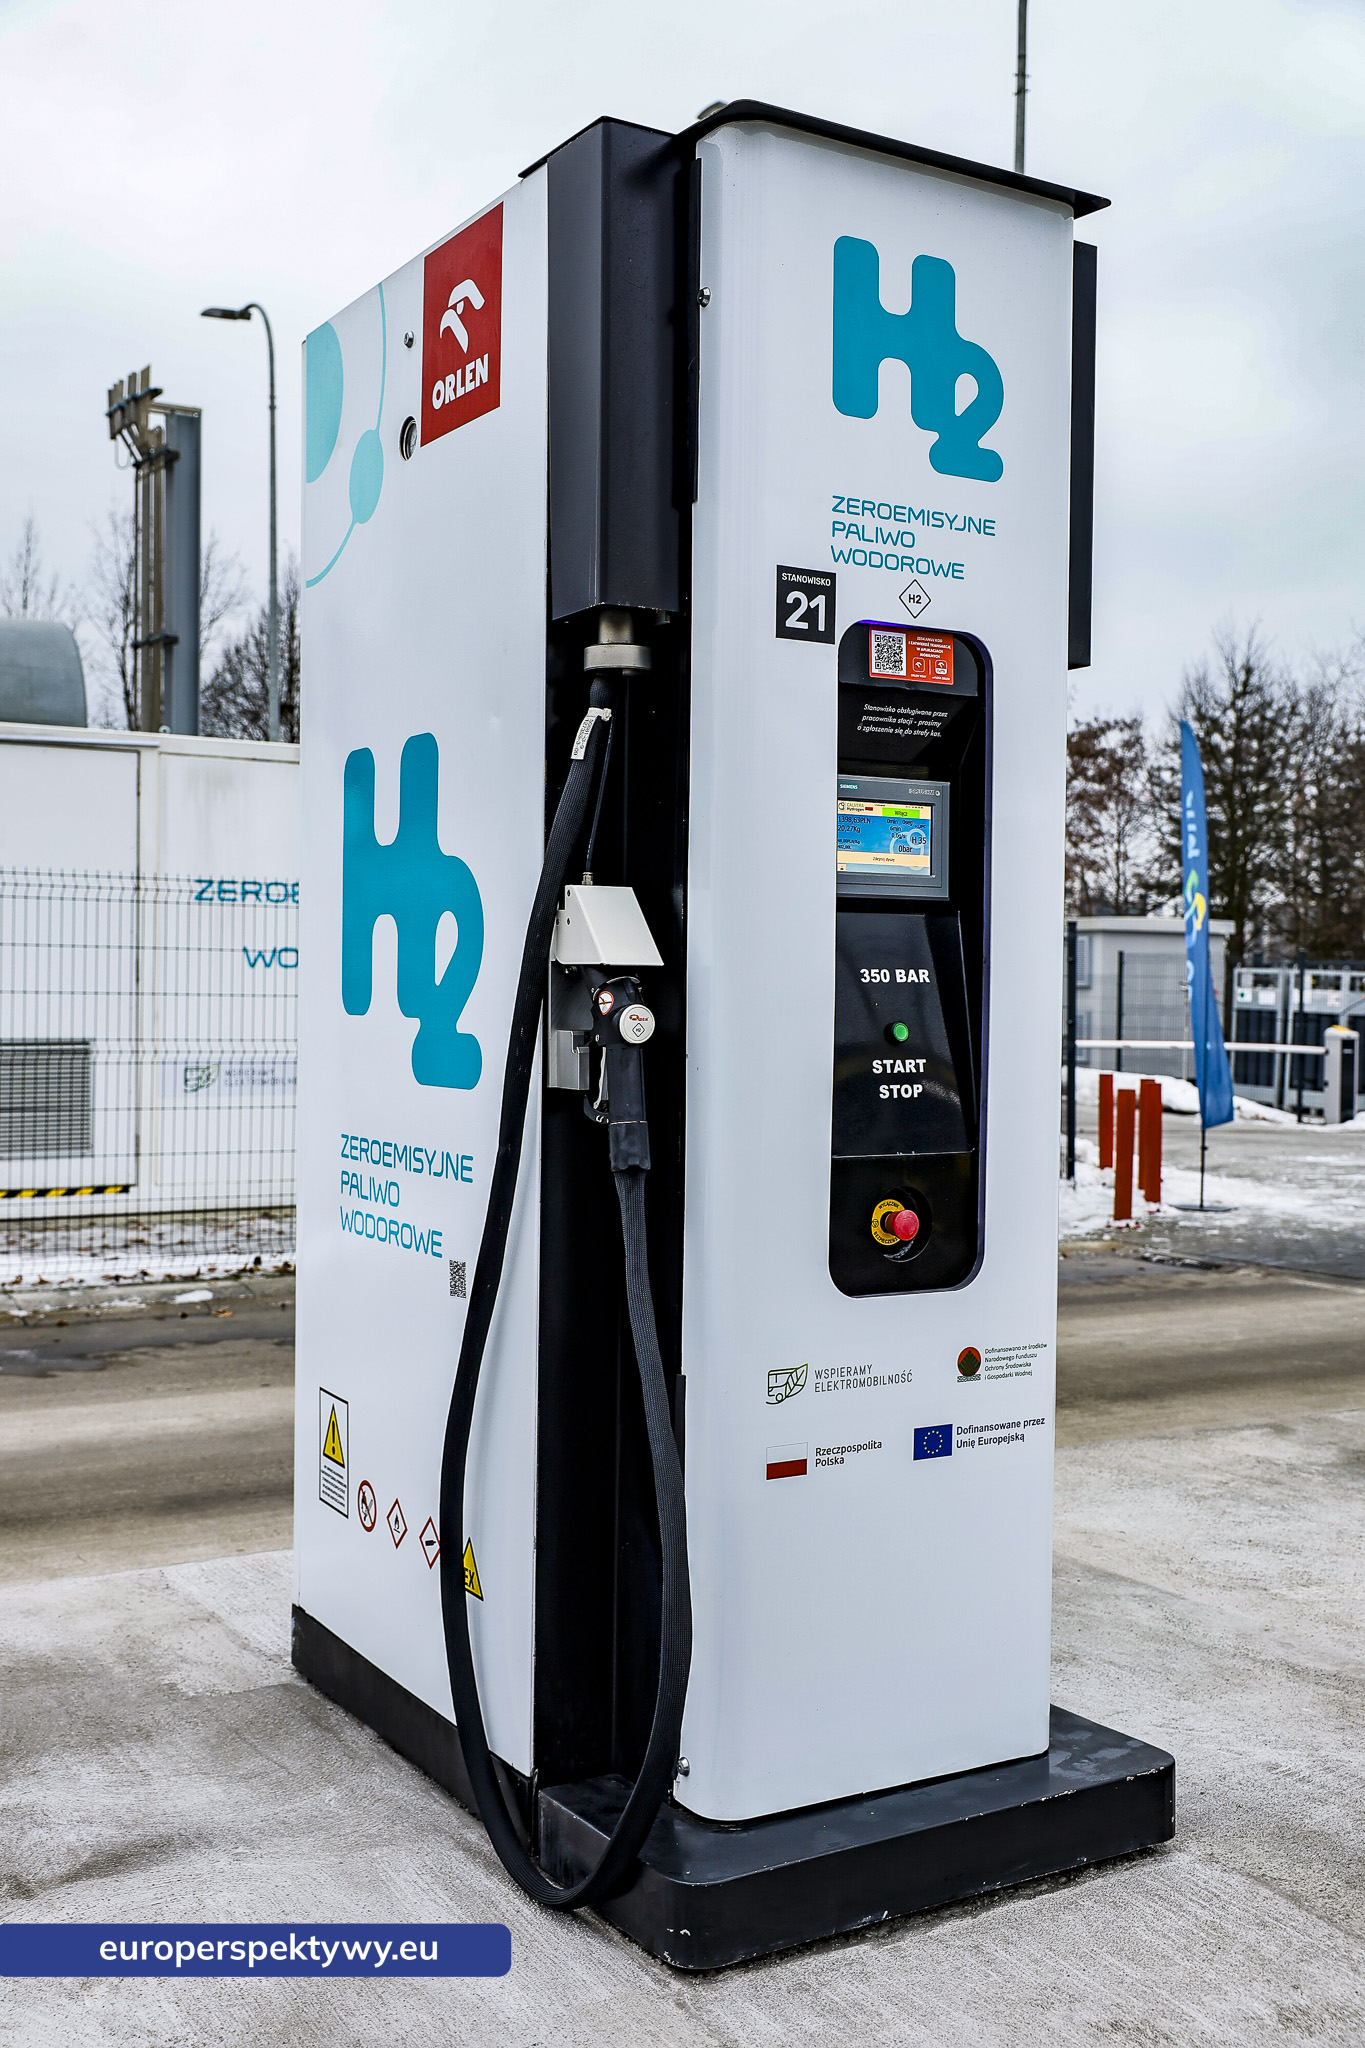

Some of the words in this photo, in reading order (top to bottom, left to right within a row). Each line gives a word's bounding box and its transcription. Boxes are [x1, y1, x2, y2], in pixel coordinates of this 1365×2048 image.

[832, 235, 1004, 483] H2
[432, 352, 489, 410] ORLEN
[831, 495, 996, 537] ZEROEMISYJNE
[831, 520, 916, 549] PALIWO
[830, 545, 966, 580] WODOROWE
[781, 572, 831, 587] STANOWISKO
[908, 594, 922, 605] H2
[785, 590, 826, 632] 21
[864, 703, 896, 713] Stanowisko
[896, 706, 932, 716] obsługiwane
[861, 715, 896, 723] pracownika
[897, 717, 914, 726] stacji
[917, 719, 941, 728] prosimy
[862, 724, 894, 733] zgłoszenie
[894, 726, 904, 735] się
[913, 728, 930, 738] strefy
[341, 732, 485, 1090] H2
[243, 946, 299, 968] WO
[859, 968, 890, 983] 350
[895, 968, 931, 983] BAR
[872, 1058, 926, 1074] START
[879, 1084, 923, 1099] STOP
[340, 1133, 473, 1183] ZEROEMISYJNE
[340, 1170, 400, 1207] PALIWO
[340, 1205, 443, 1258] WODOROWE
[1028, 1342, 1048, 1350] środków
[984, 1355, 1015, 1363] Narodowego
[1005, 1361, 1032, 1370] Środowiska
[814, 1364, 873, 1380] WSPIERAMY
[814, 1369, 913, 1392] ELEKTROMOBILNOŚĆ
[987, 1372, 1014, 1380] Gospodarki
[956, 1421, 1021, 1435] Dofinansowane
[1023, 1417, 1045, 1429] przez
[815, 1440, 882, 1457] Rzeczpospolita
[956, 1438, 976, 1449] Unię
[977, 1432, 1025, 1445] Europejską
[815, 1456, 845, 1467] Polska
